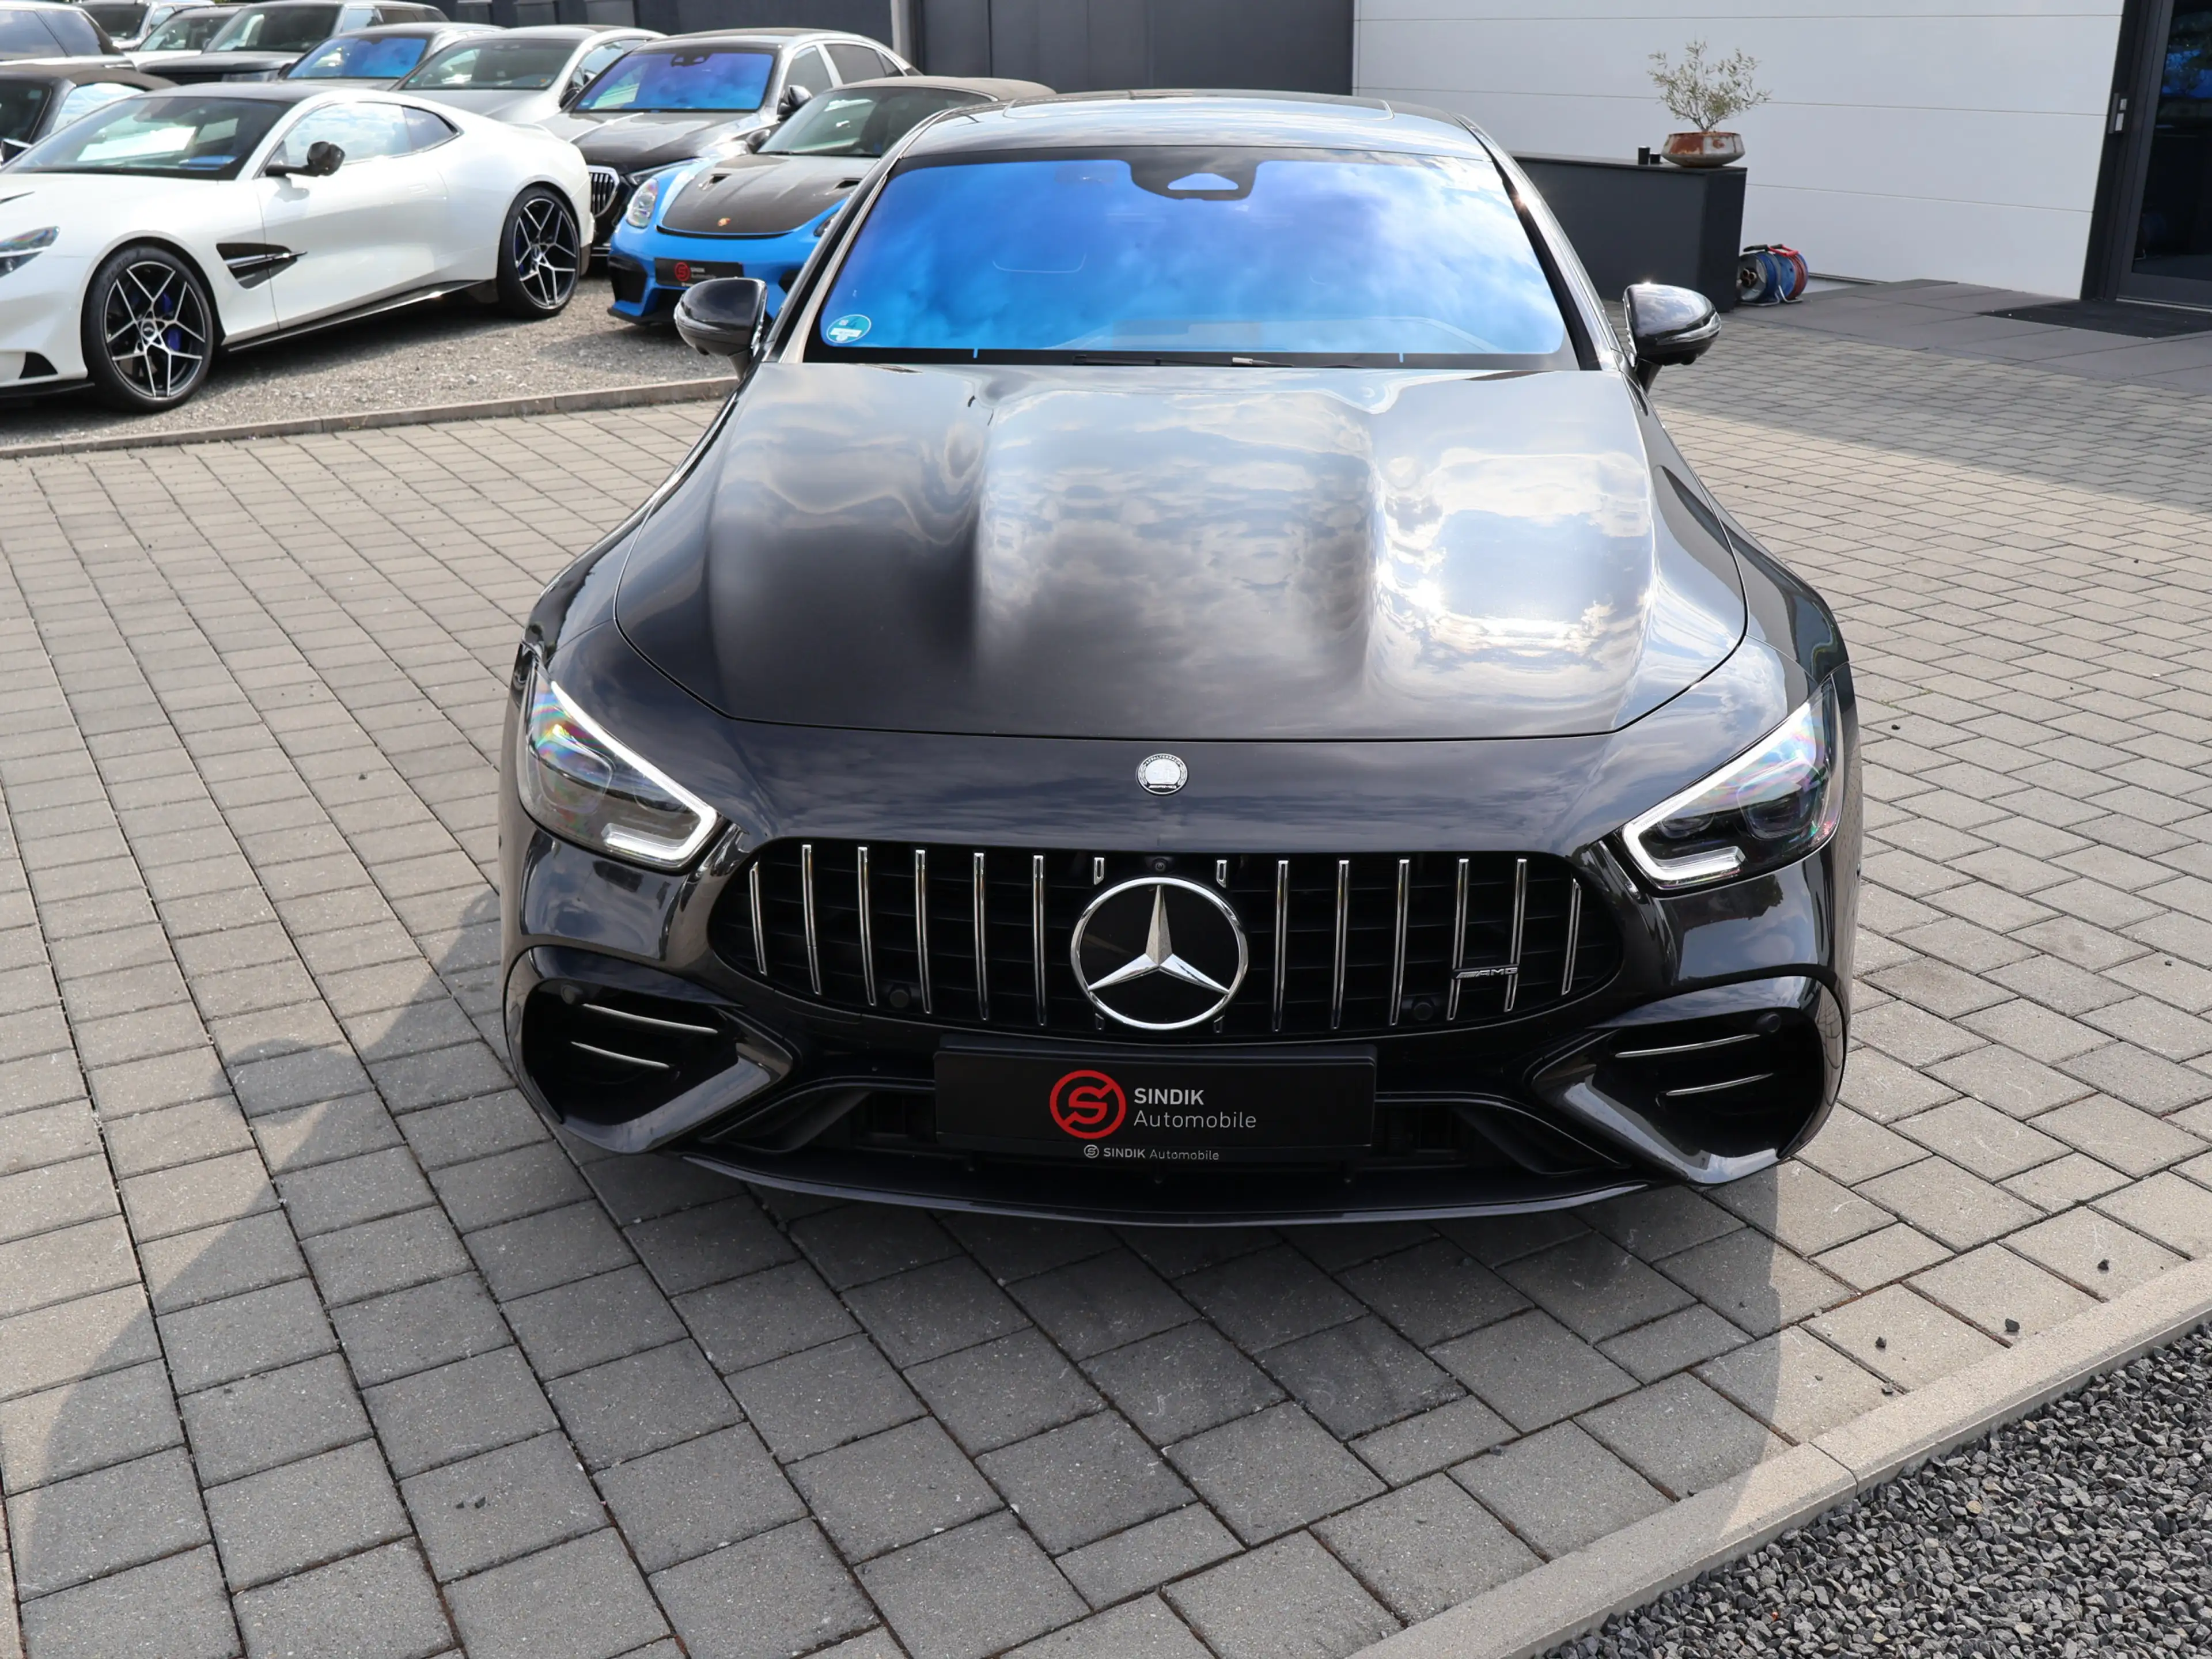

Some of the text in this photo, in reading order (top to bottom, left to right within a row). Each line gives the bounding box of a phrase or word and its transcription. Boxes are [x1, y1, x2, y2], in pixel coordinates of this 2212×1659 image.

[1475, 967, 1518, 977] AMG
[1134, 1088, 1204, 1105] SINDIK
[1134, 1111, 1256, 1128] Automobile
[1104, 1148, 1145, 1158] SINDIK
[1150, 1149, 1219, 1160] Automobile
